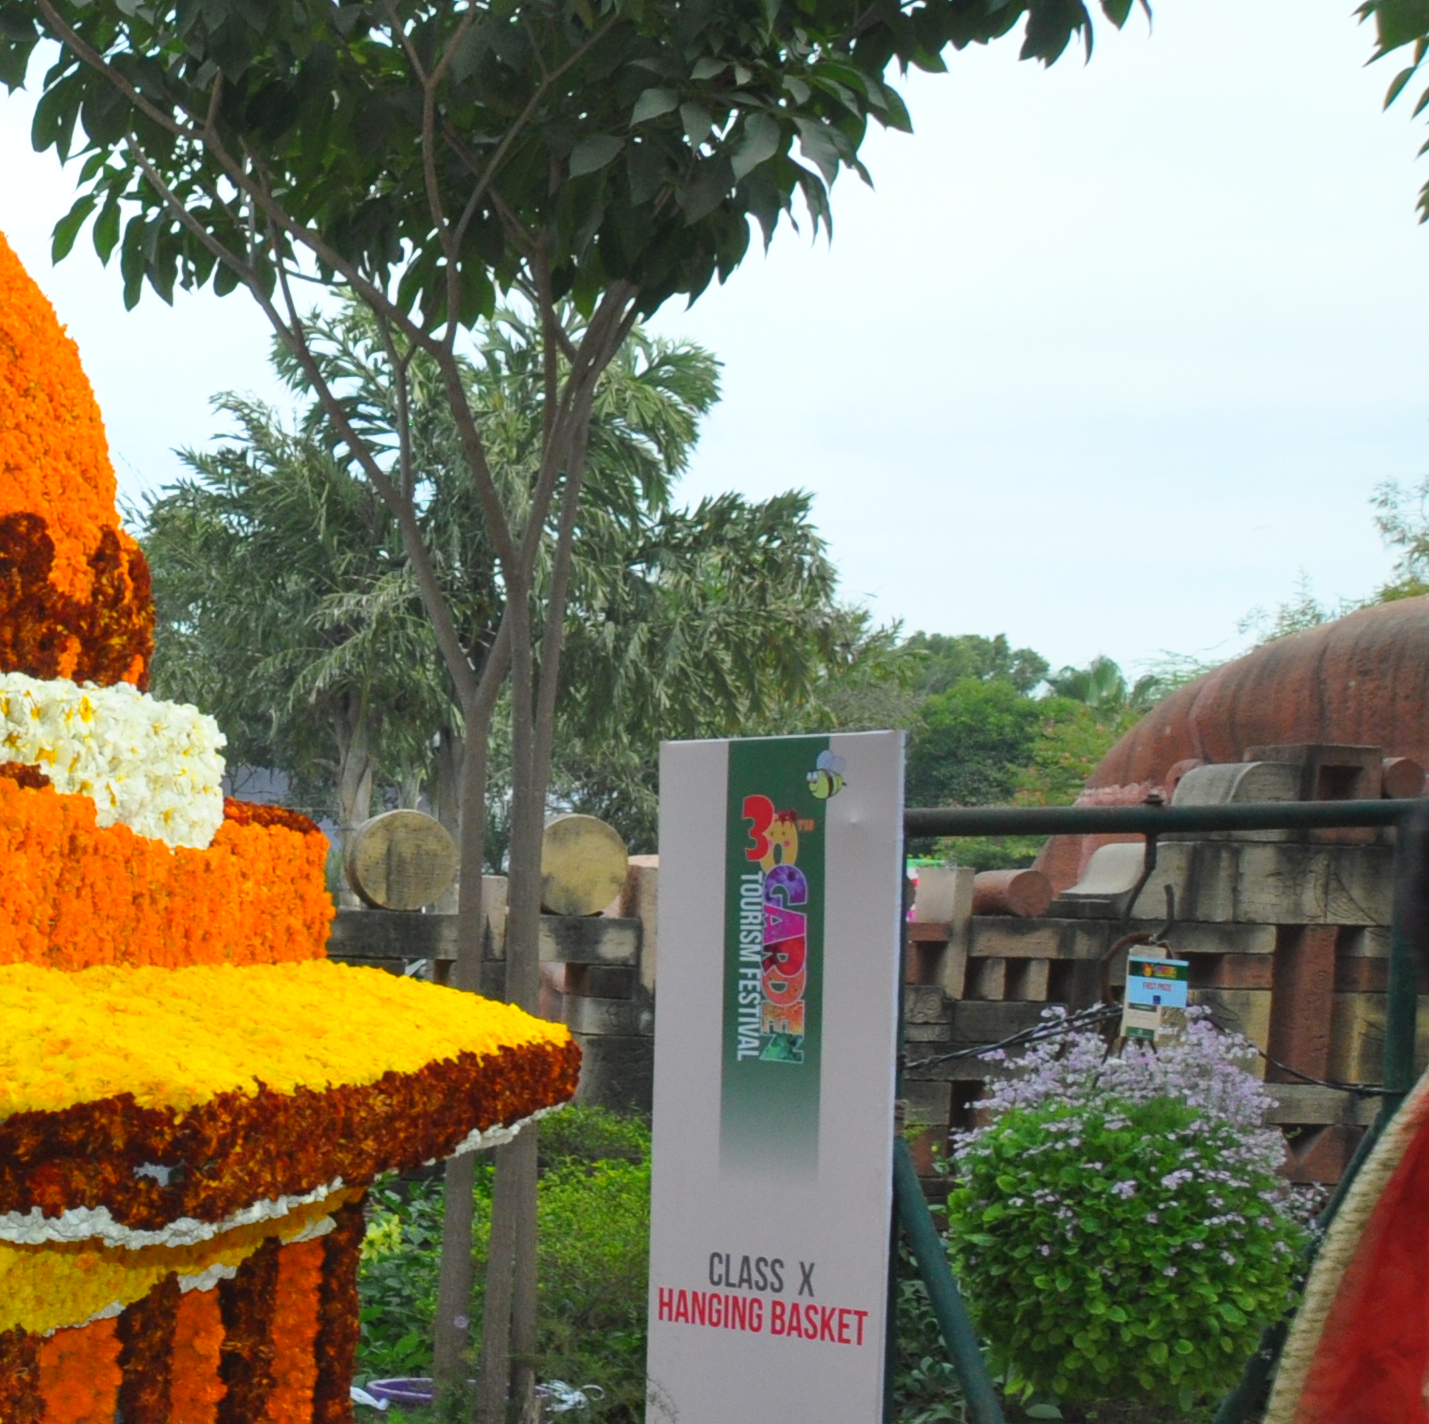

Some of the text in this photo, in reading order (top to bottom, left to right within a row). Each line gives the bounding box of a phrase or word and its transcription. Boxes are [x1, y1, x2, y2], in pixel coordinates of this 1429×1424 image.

[736, 870, 764, 1062] TOURISM FESTIVAL
[759, 864, 808, 1064] GARDEN
[658, 1286, 869, 1346] HANGING BASKET
[708, 1251, 815, 1298] CLASS X
